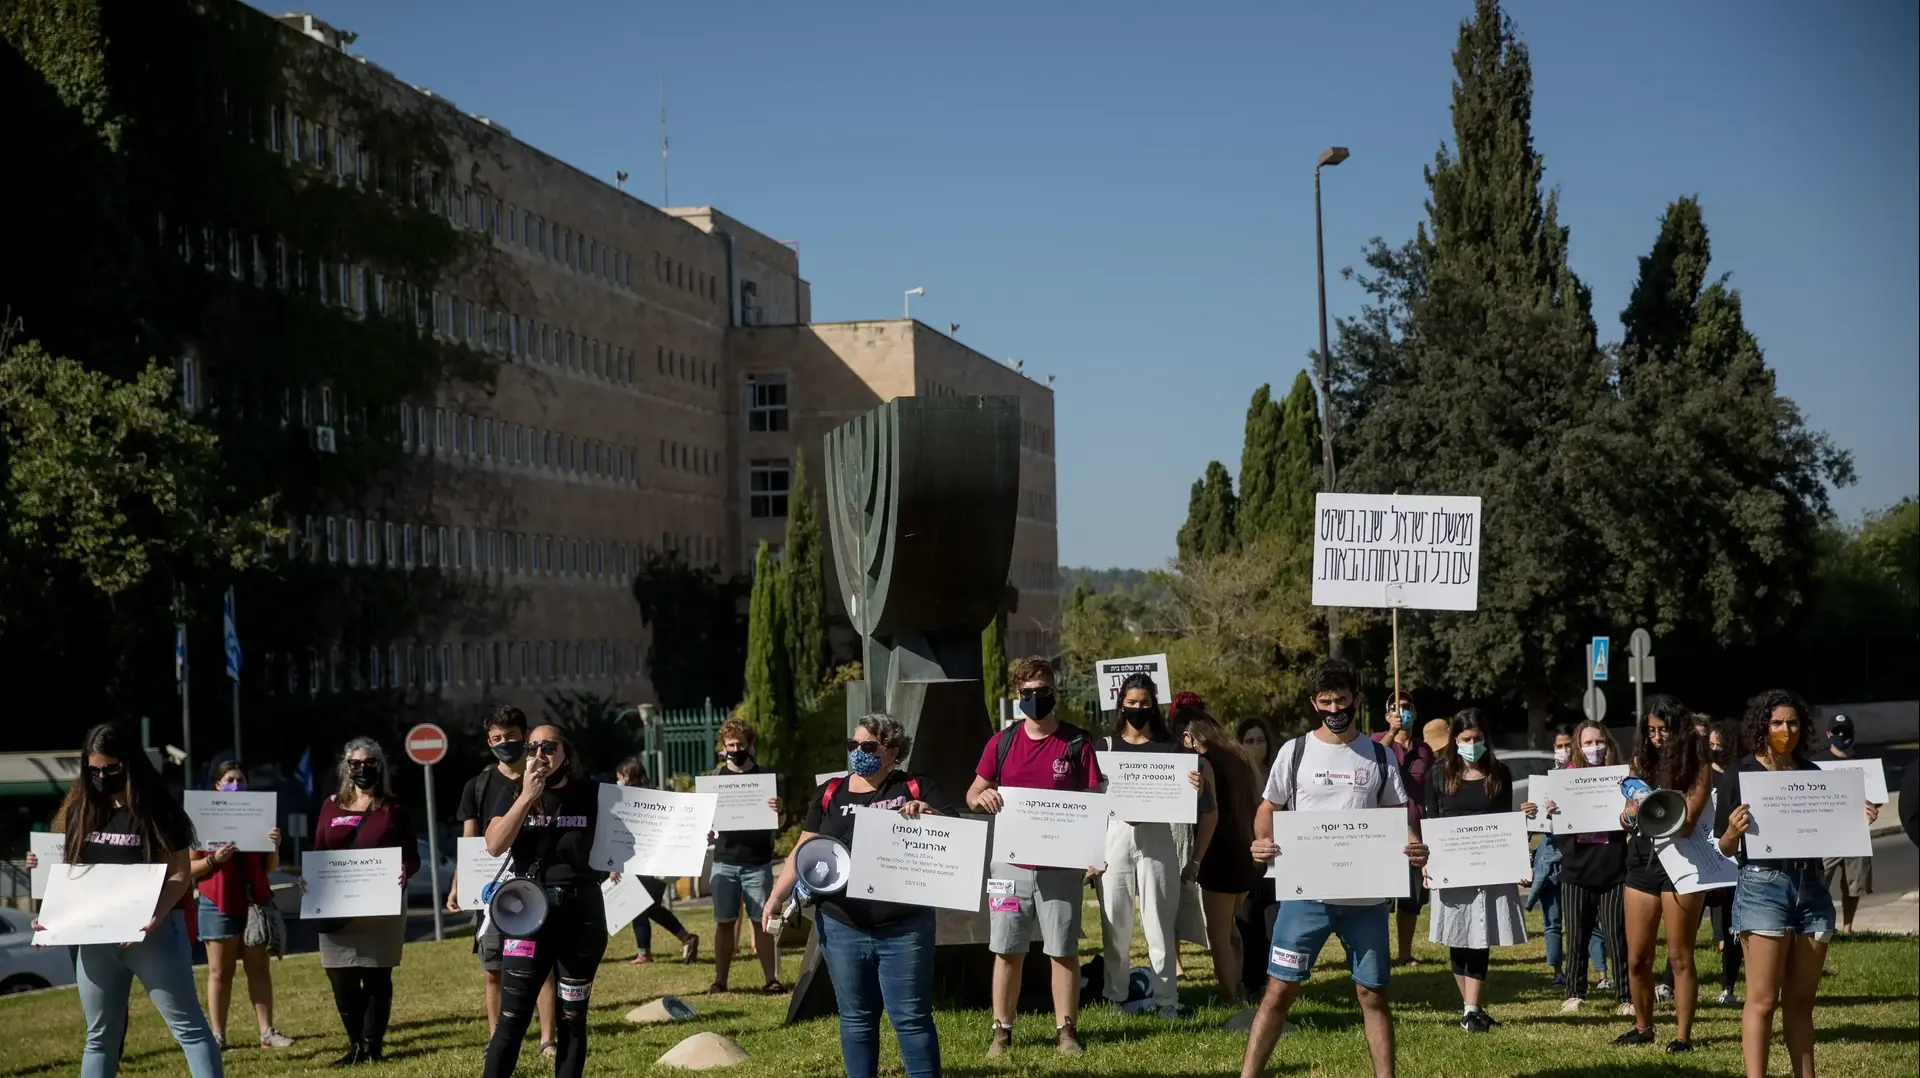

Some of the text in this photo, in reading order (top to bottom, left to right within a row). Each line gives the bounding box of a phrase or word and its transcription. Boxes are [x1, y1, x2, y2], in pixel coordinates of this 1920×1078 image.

[1321, 505, 1473, 546] ממשלת ישראל ישנה בשקט
[1366, 550, 1428, 584] הנרצחות
[1431, 548, 1450, 584] כל
[1452, 551, 1472, 584] עם
[1788, 783, 1805, 791] סלה
[633, 801, 667, 811] אלמונית
[892, 824, 950, 838] אסתר (אסתי)
[1322, 824, 1340, 832] יוסף
[902, 838, 947, 852] אהרונוביץ'
